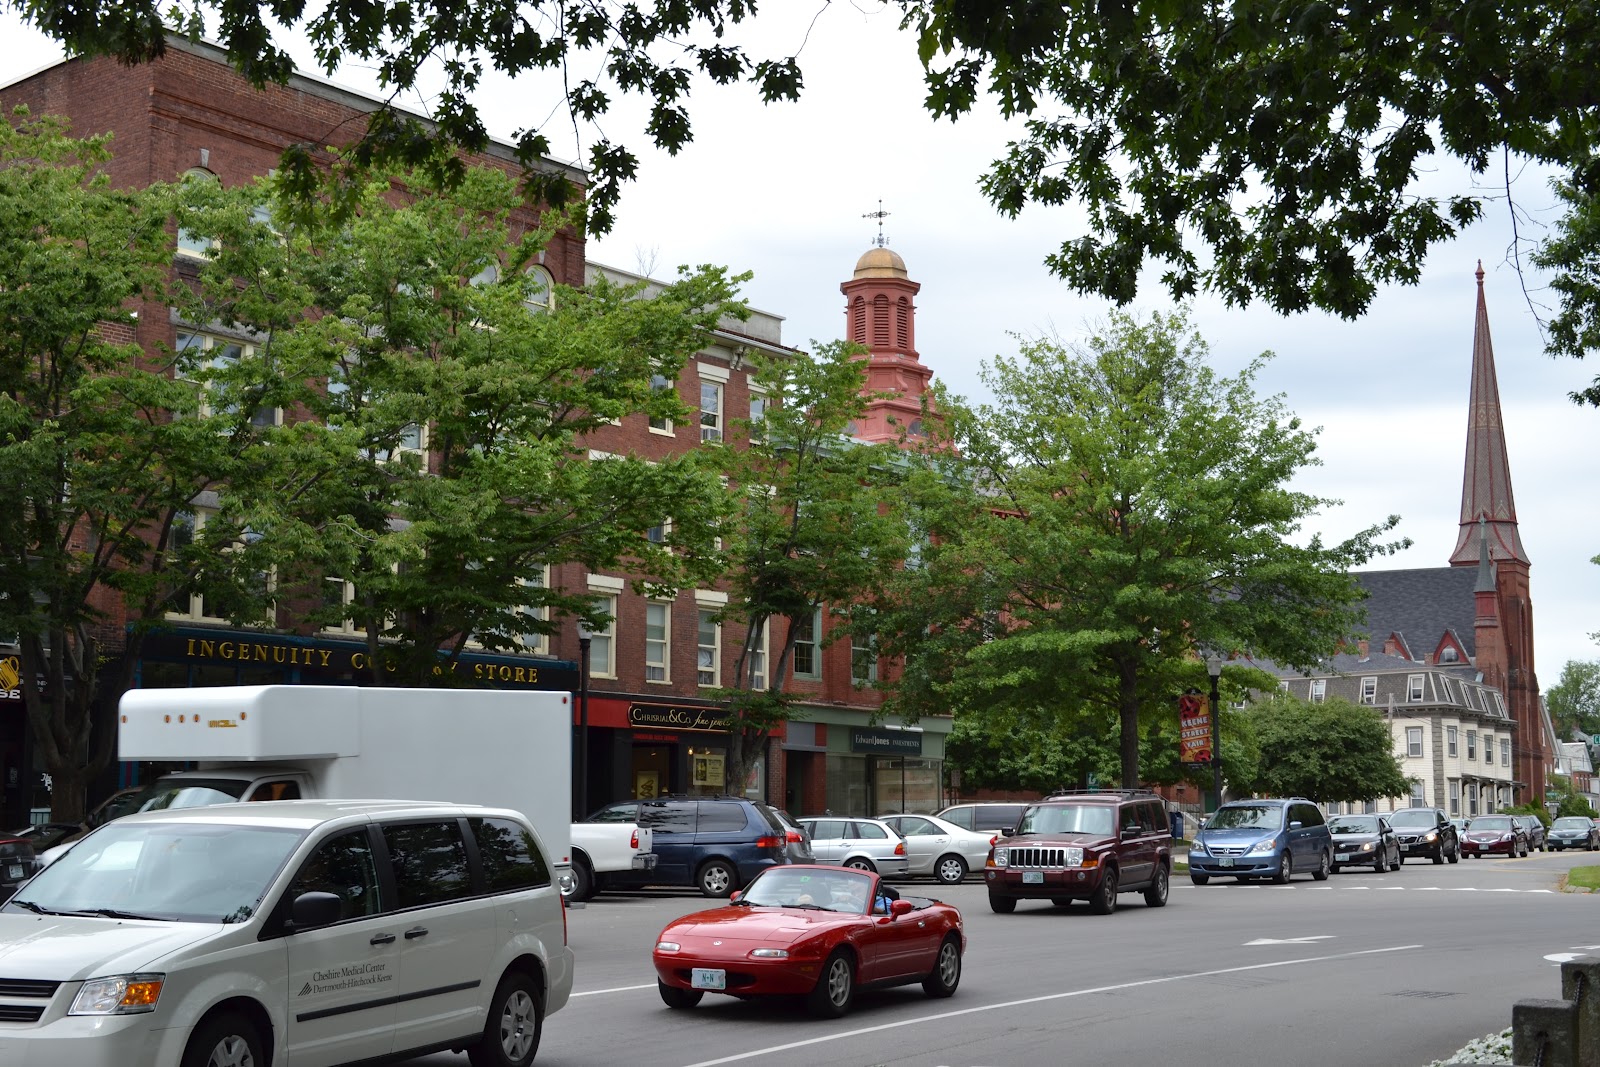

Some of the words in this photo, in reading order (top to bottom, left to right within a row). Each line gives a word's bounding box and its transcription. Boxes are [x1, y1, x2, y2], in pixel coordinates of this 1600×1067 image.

[187, 639, 332, 667] INGENUITY
[475, 663, 539, 683] STORE
[1181, 717, 1208, 727] KEENE
[1181, 728, 1208, 738] STREET
[1187, 740, 1205, 748] FAIR
[313, 969, 340, 982] Cheshire
[341, 964, 365, 977] Medical
[366, 963, 385, 974] Center
[376, 974, 392, 983] Keene
